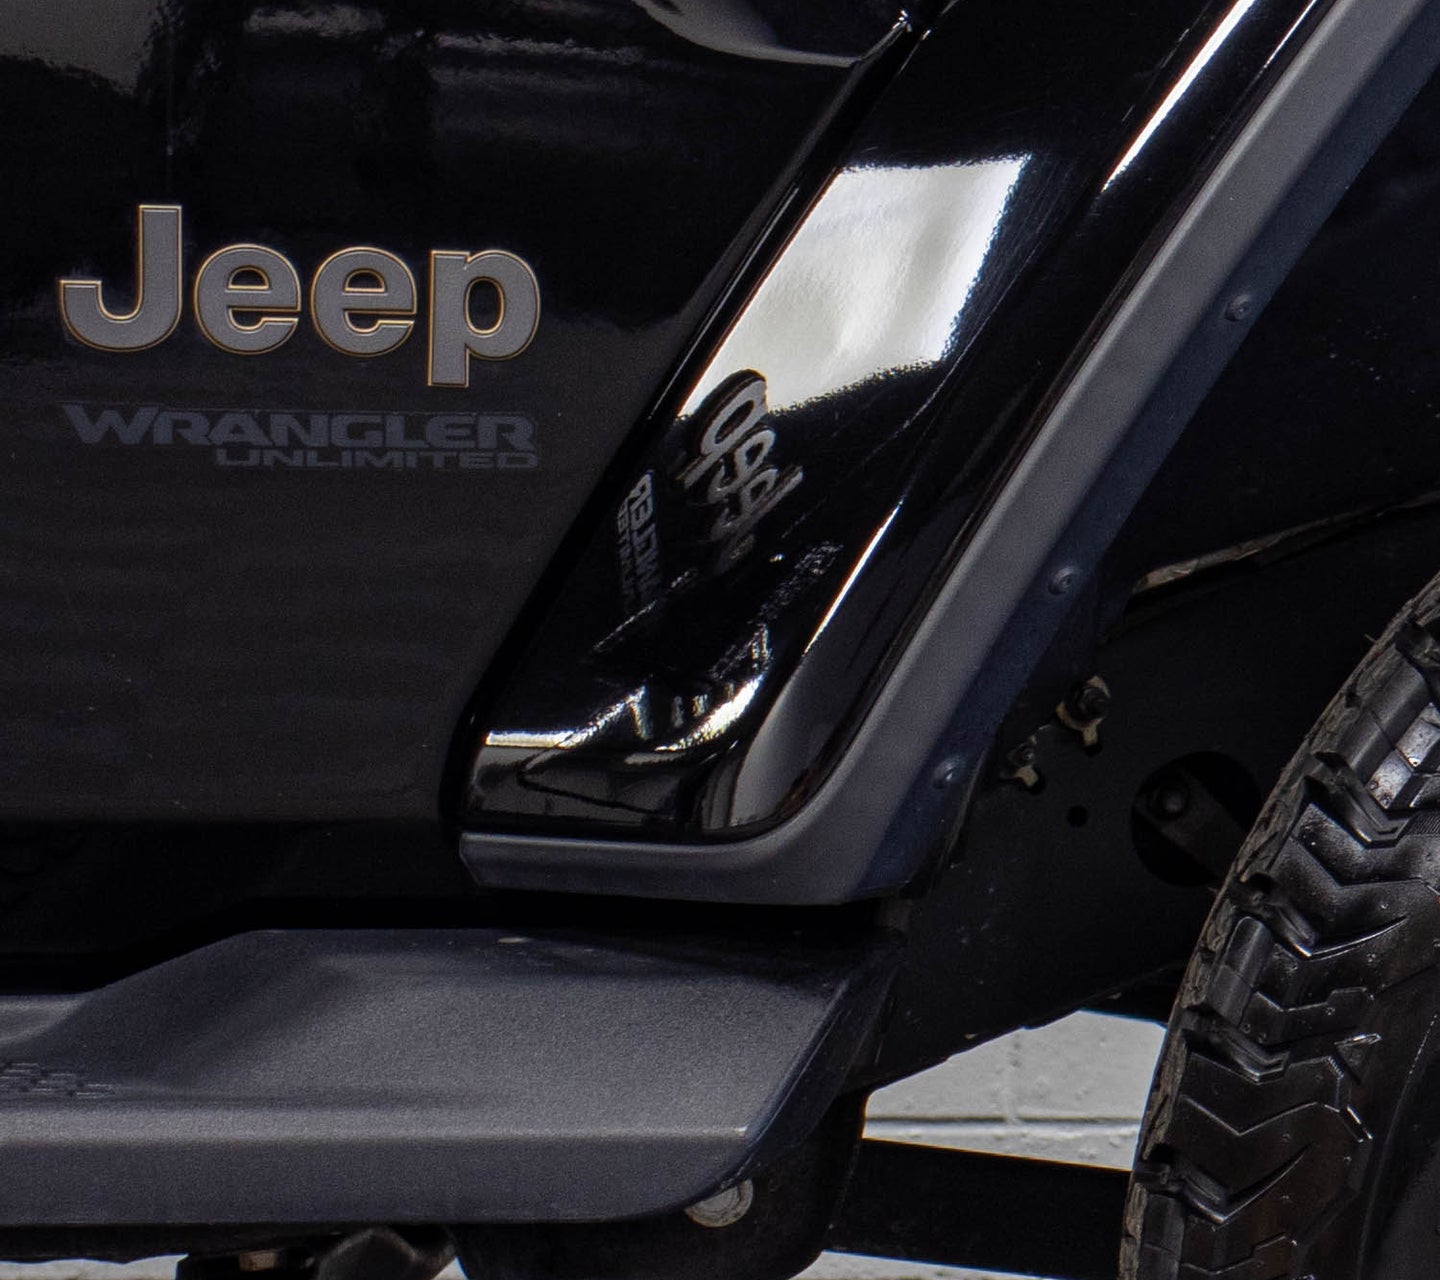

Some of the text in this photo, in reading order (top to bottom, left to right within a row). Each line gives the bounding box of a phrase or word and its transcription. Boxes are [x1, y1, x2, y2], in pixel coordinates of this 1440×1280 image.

[60, 204, 540, 387] Jeep
[61, 403, 538, 448] WRANGLER
[215, 448, 539, 469] UNLIMITED
